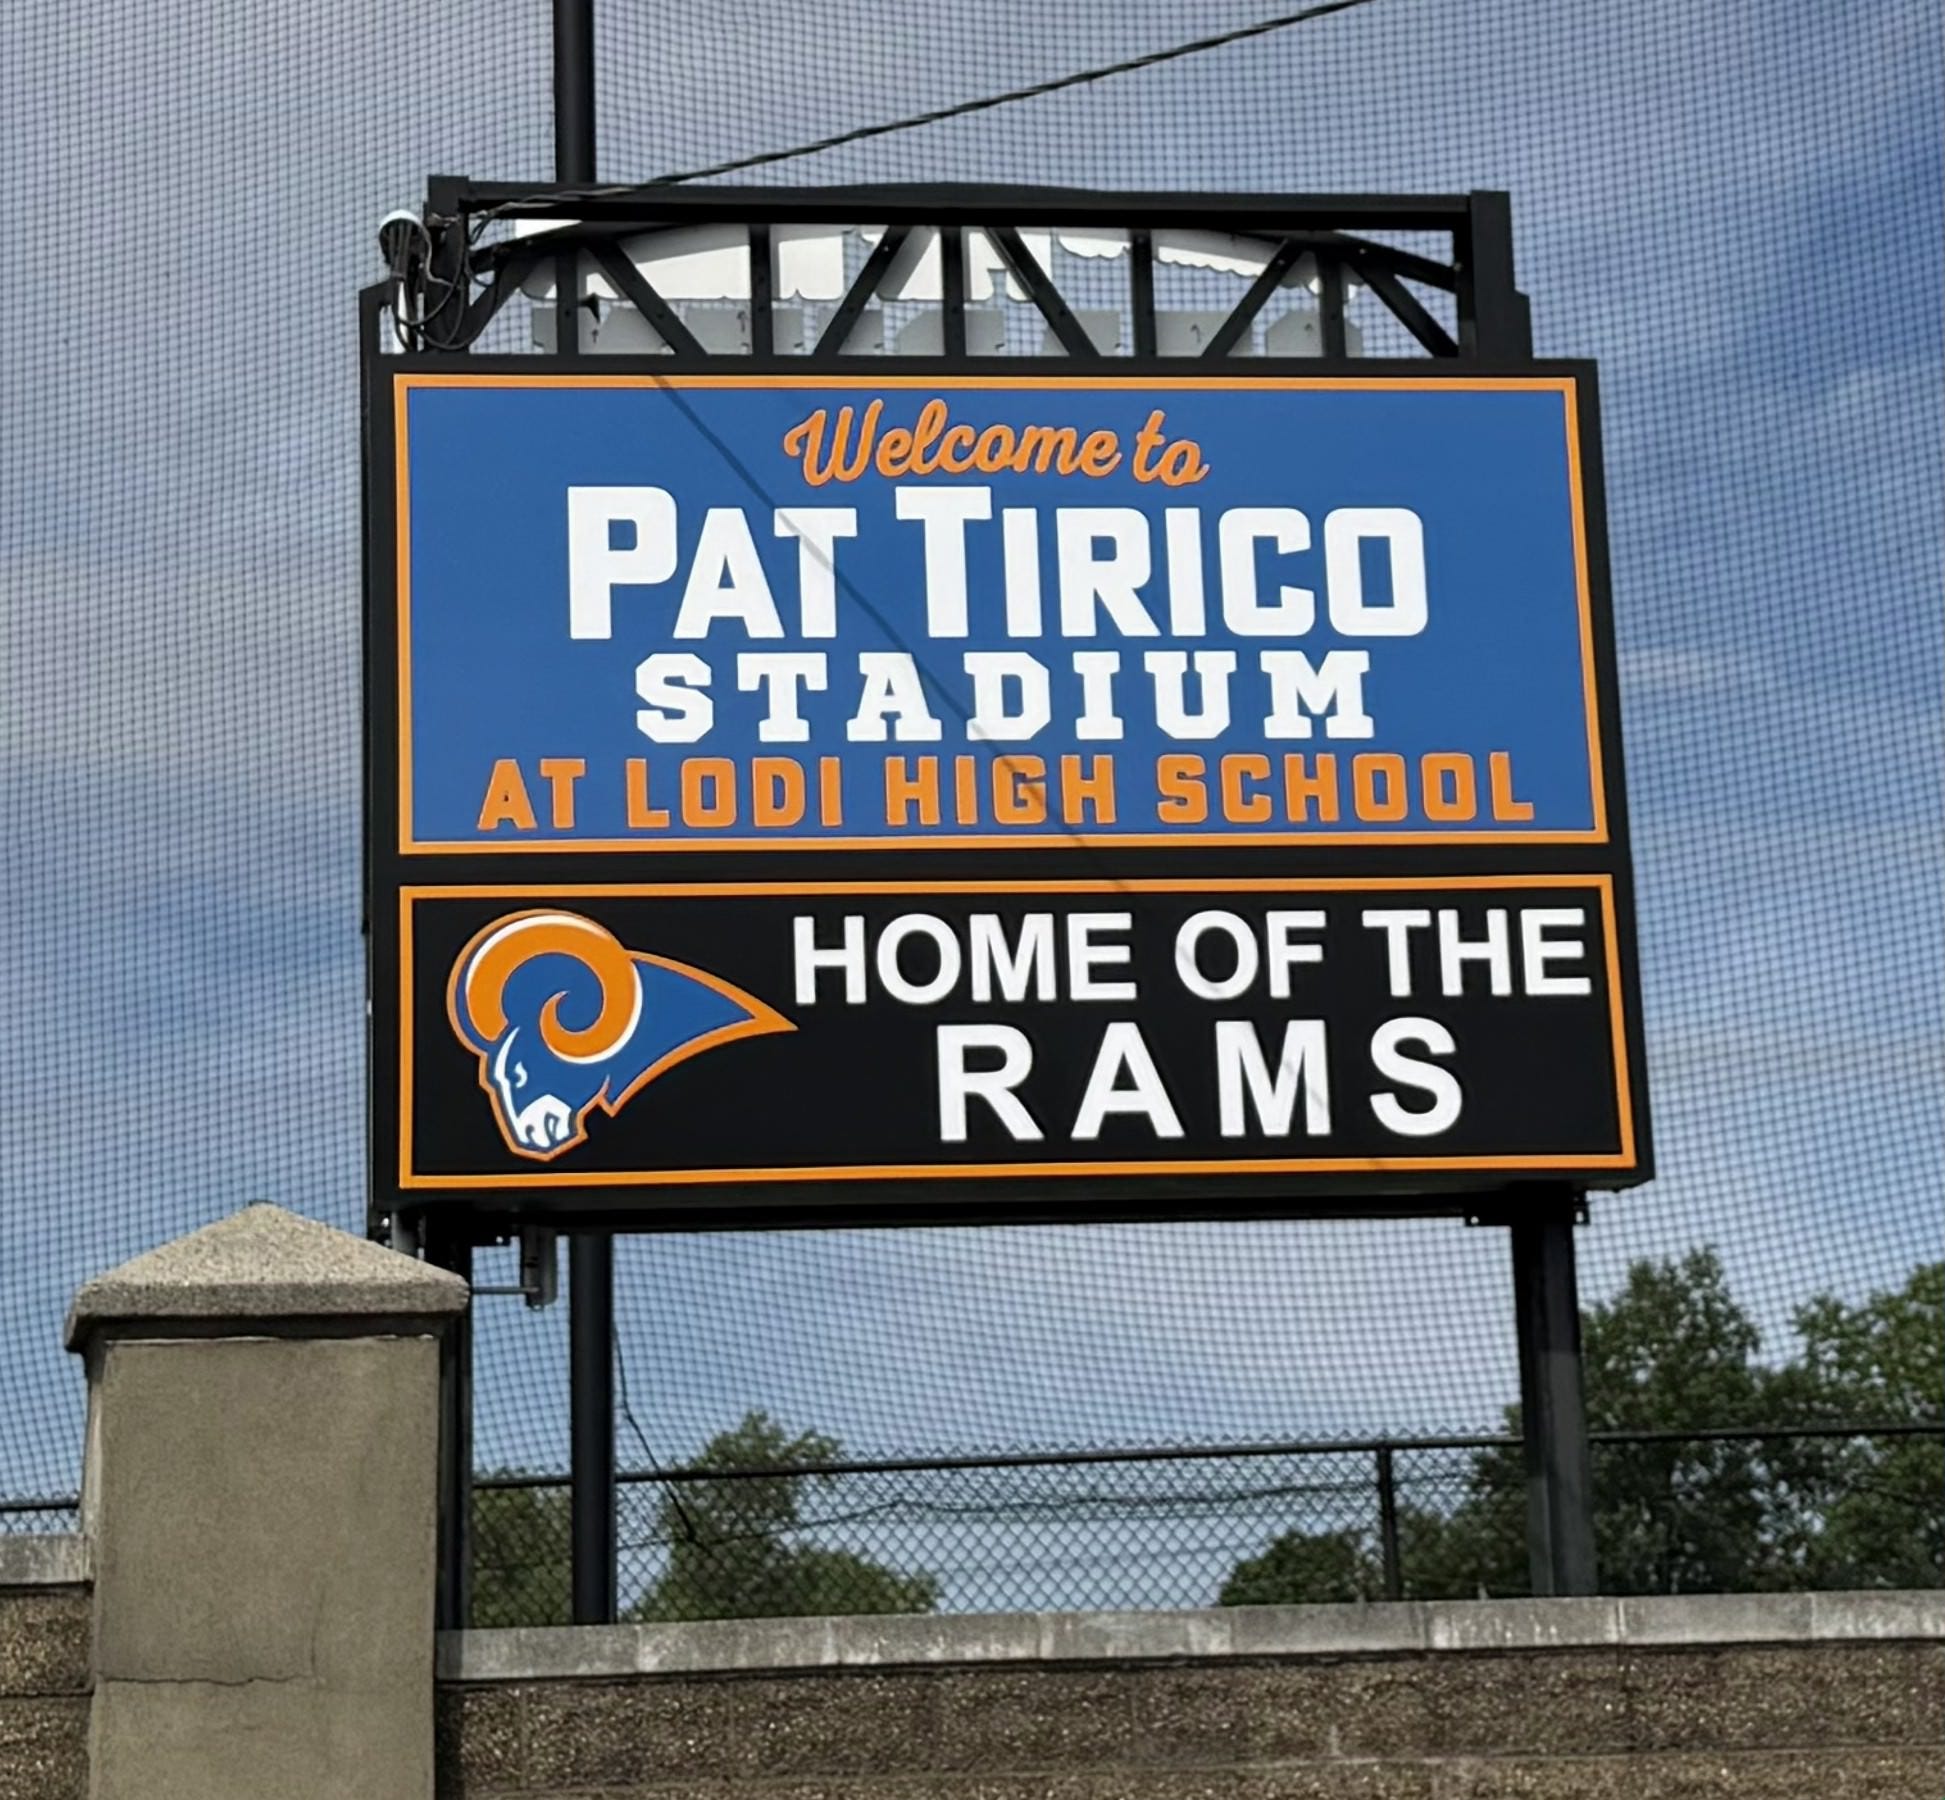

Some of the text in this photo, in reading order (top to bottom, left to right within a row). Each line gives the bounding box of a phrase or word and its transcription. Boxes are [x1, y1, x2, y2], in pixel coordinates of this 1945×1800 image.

[784, 401, 1208, 486] Welcome to
[567, 486, 1428, 640] PAT TIRICO
[635, 651, 1374, 744] STADIUM
[480, 754, 1532, 830] AT LODI HIGH SCHOOL
[794, 909, 1590, 1004] HOME OF THE
[938, 1018, 1461, 1141] RAMS
